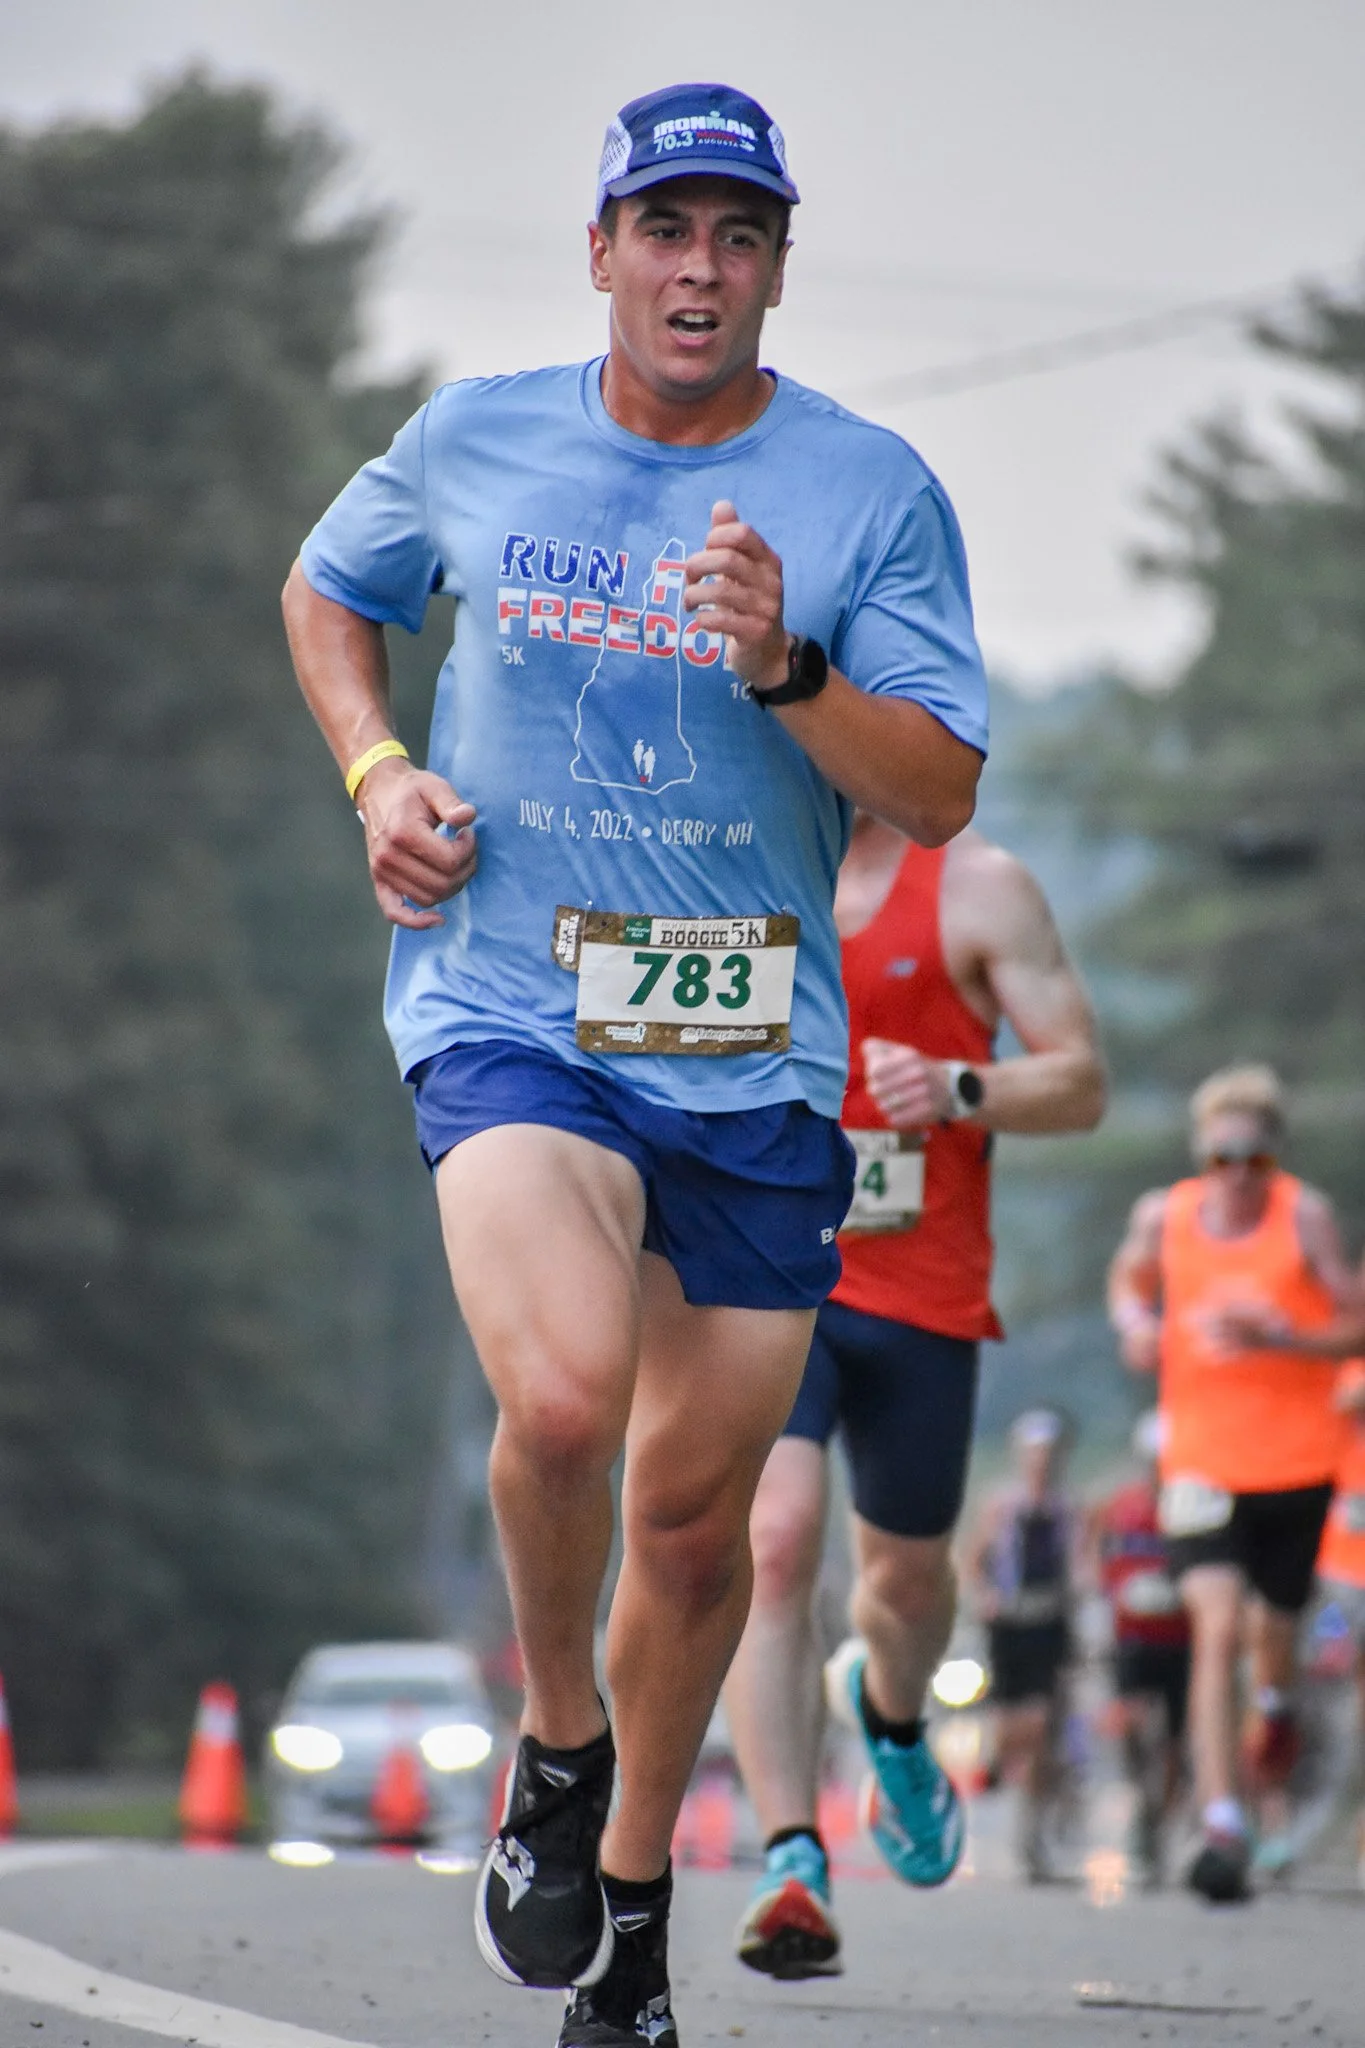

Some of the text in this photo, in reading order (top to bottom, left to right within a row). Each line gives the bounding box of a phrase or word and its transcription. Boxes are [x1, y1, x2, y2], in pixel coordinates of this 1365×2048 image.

[653, 111, 757, 141] IRONMAN
[653, 131, 695, 154] 70.3
[499, 531, 629, 598] RUN
[497, 586, 733, 672] FREEDO
[502, 644, 526, 667] 5K
[518, 798, 555, 834] JULY
[589, 808, 634, 842] 2022
[661, 817, 717, 846] DERRY
[724, 821, 754, 848] NH
[659, 929, 728, 946] BOOGIE
[731, 921, 763, 945] 5K
[627, 951, 753, 1010] 783
[861, 1160, 888, 1199] 4
